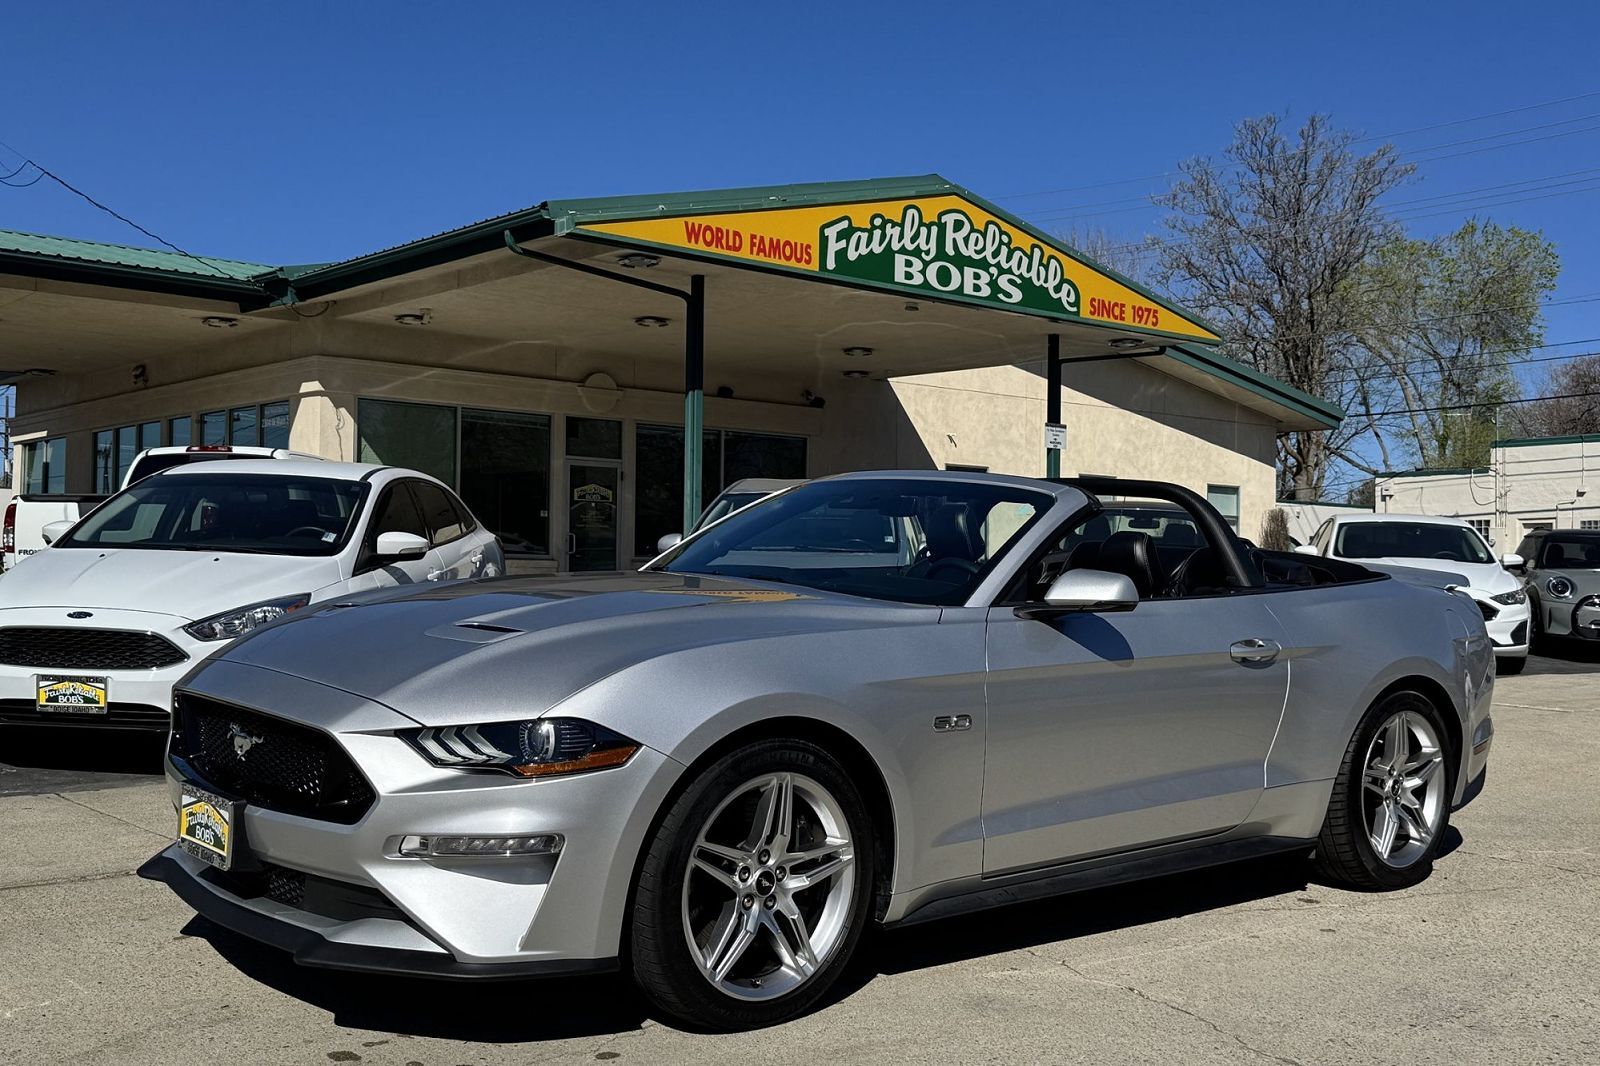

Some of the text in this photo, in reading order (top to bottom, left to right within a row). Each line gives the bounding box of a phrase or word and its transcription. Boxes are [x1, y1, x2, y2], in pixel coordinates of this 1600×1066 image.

[684, 221, 812, 265] WORLD FAMOUS
[824, 208, 1078, 312] Fairly Reliable
[894, 253, 1023, 303] BOB'S
[1089, 297, 1159, 327] SINCE 1975
[58, 694, 84, 704] BOB'S
[196, 824, 215, 845] BOB'S
